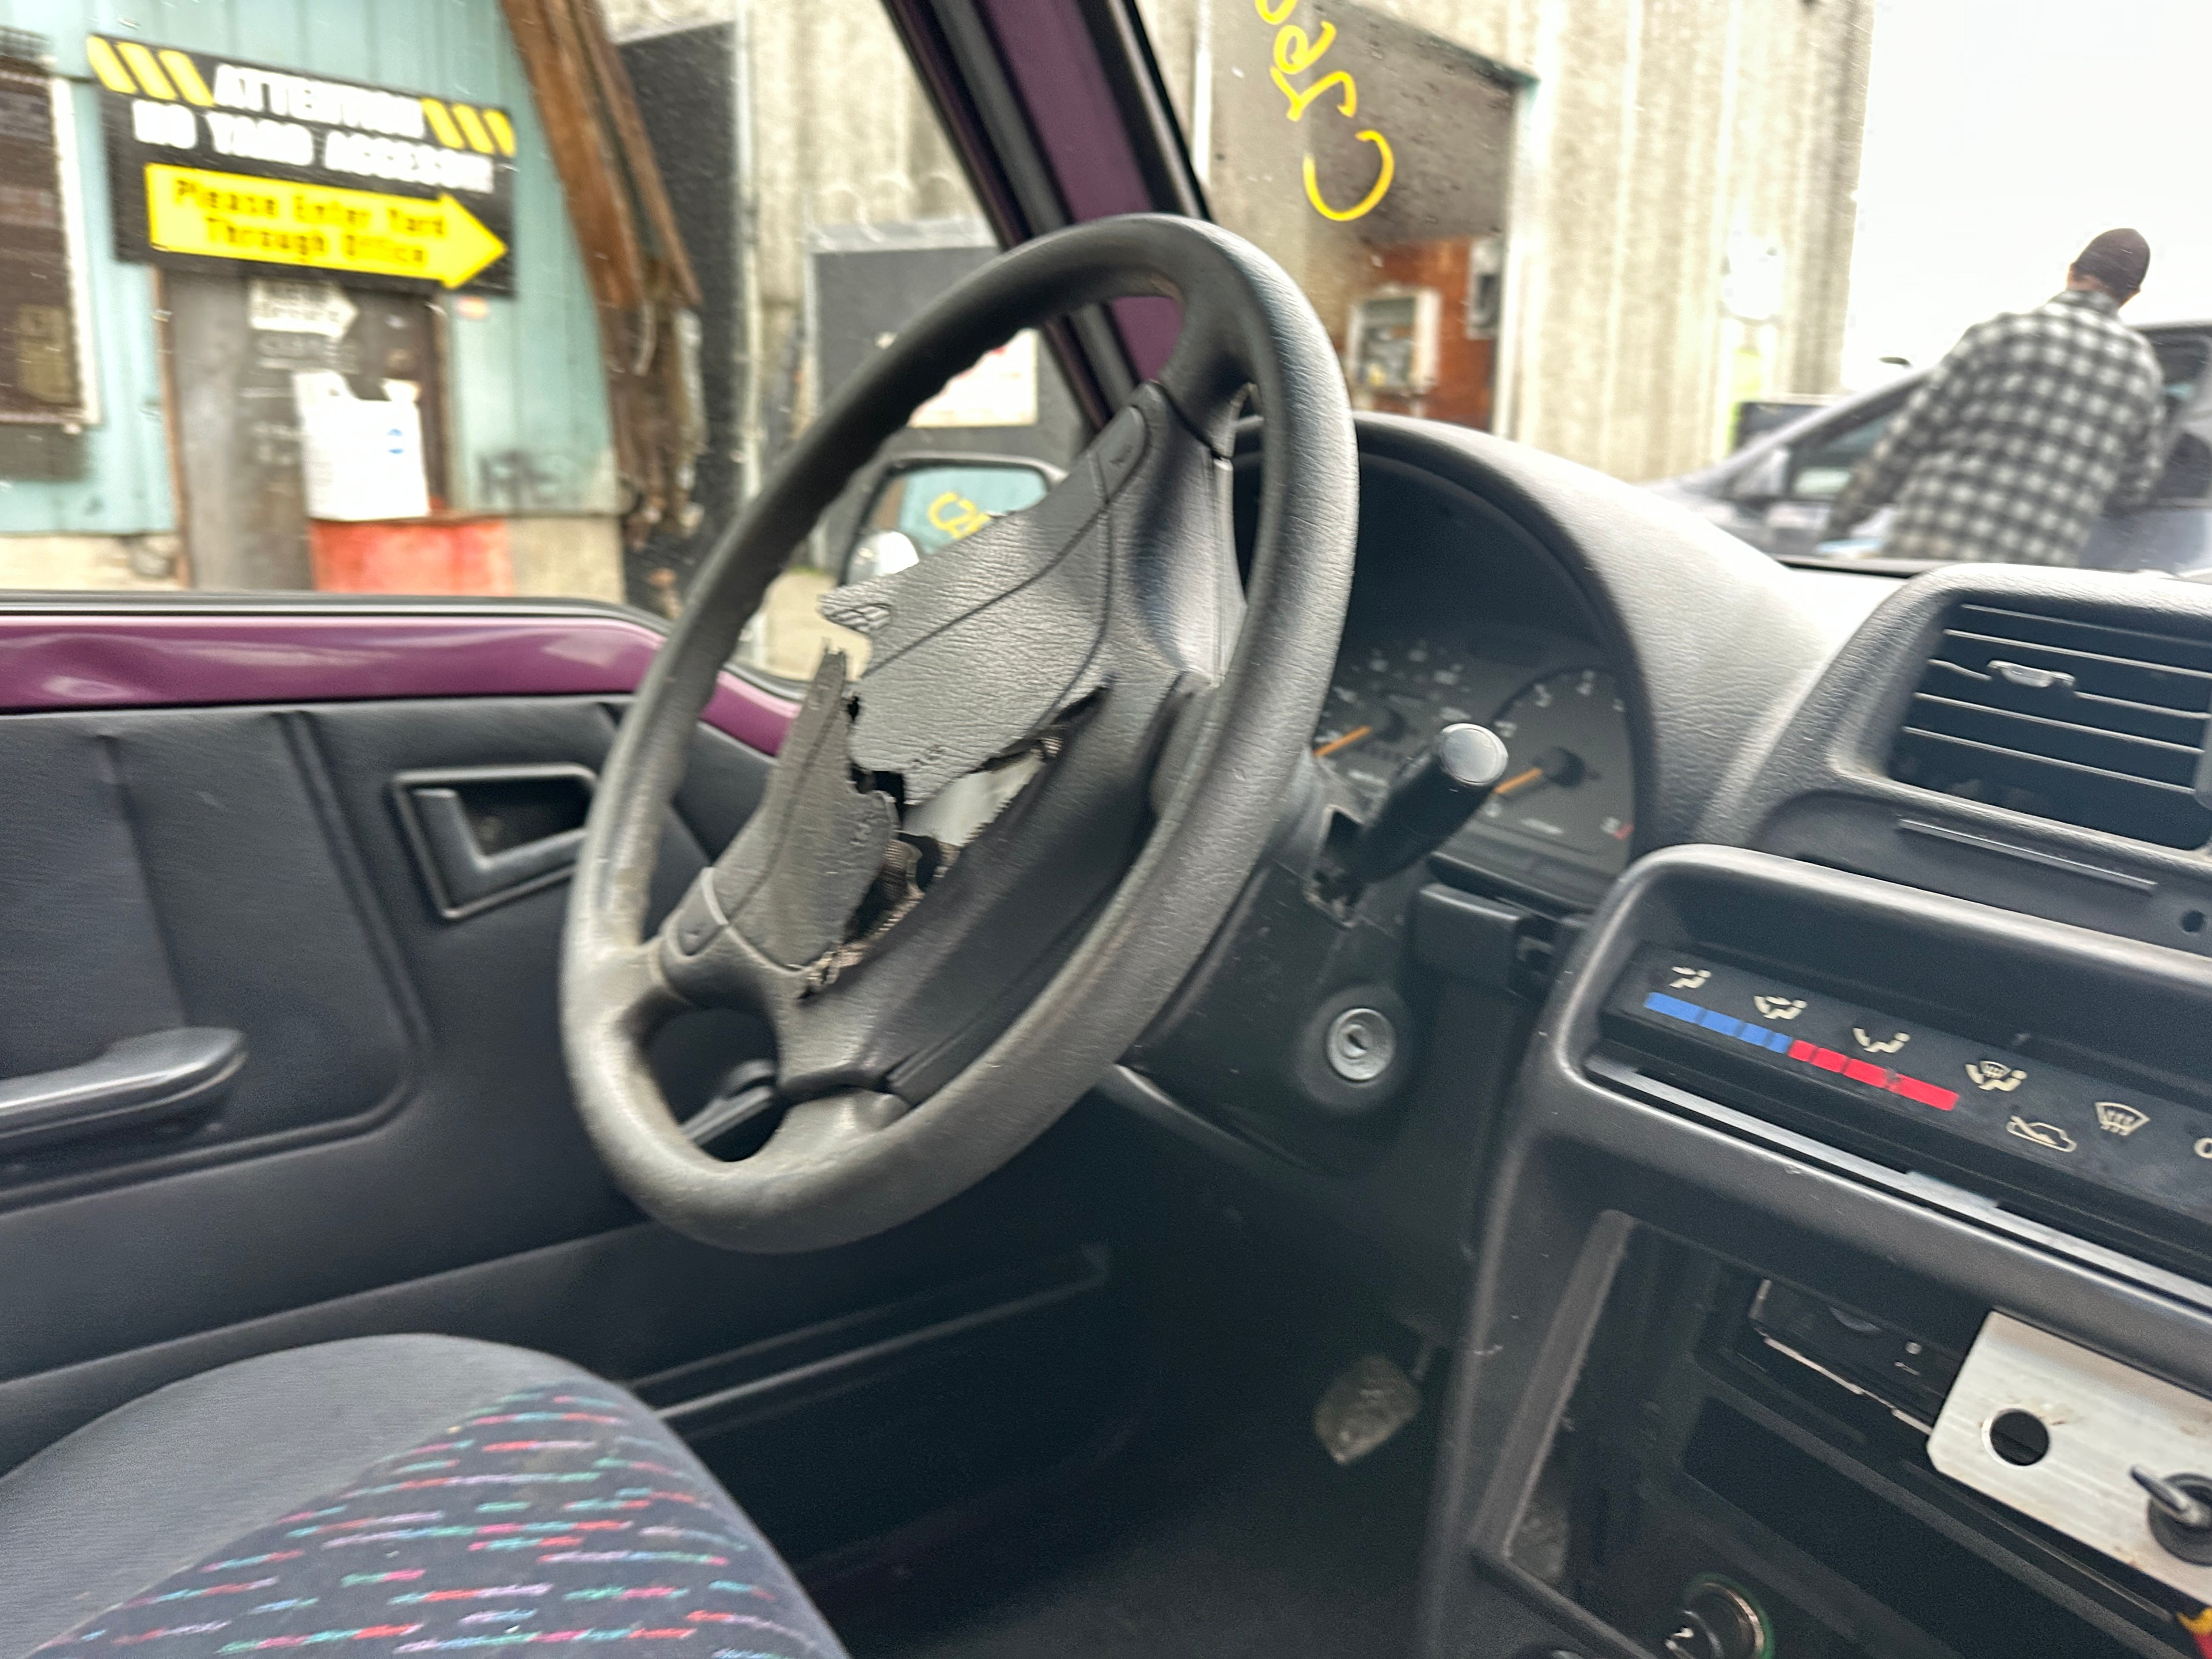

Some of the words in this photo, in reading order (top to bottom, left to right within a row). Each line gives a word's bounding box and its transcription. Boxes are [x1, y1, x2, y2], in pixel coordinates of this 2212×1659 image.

[214, 63, 425, 139] ATTENTION
[175, 177, 278, 218] Please
[293, 195, 372, 227] Enter
[387, 207, 446, 237] Yard
[206, 215, 327, 263] Through
